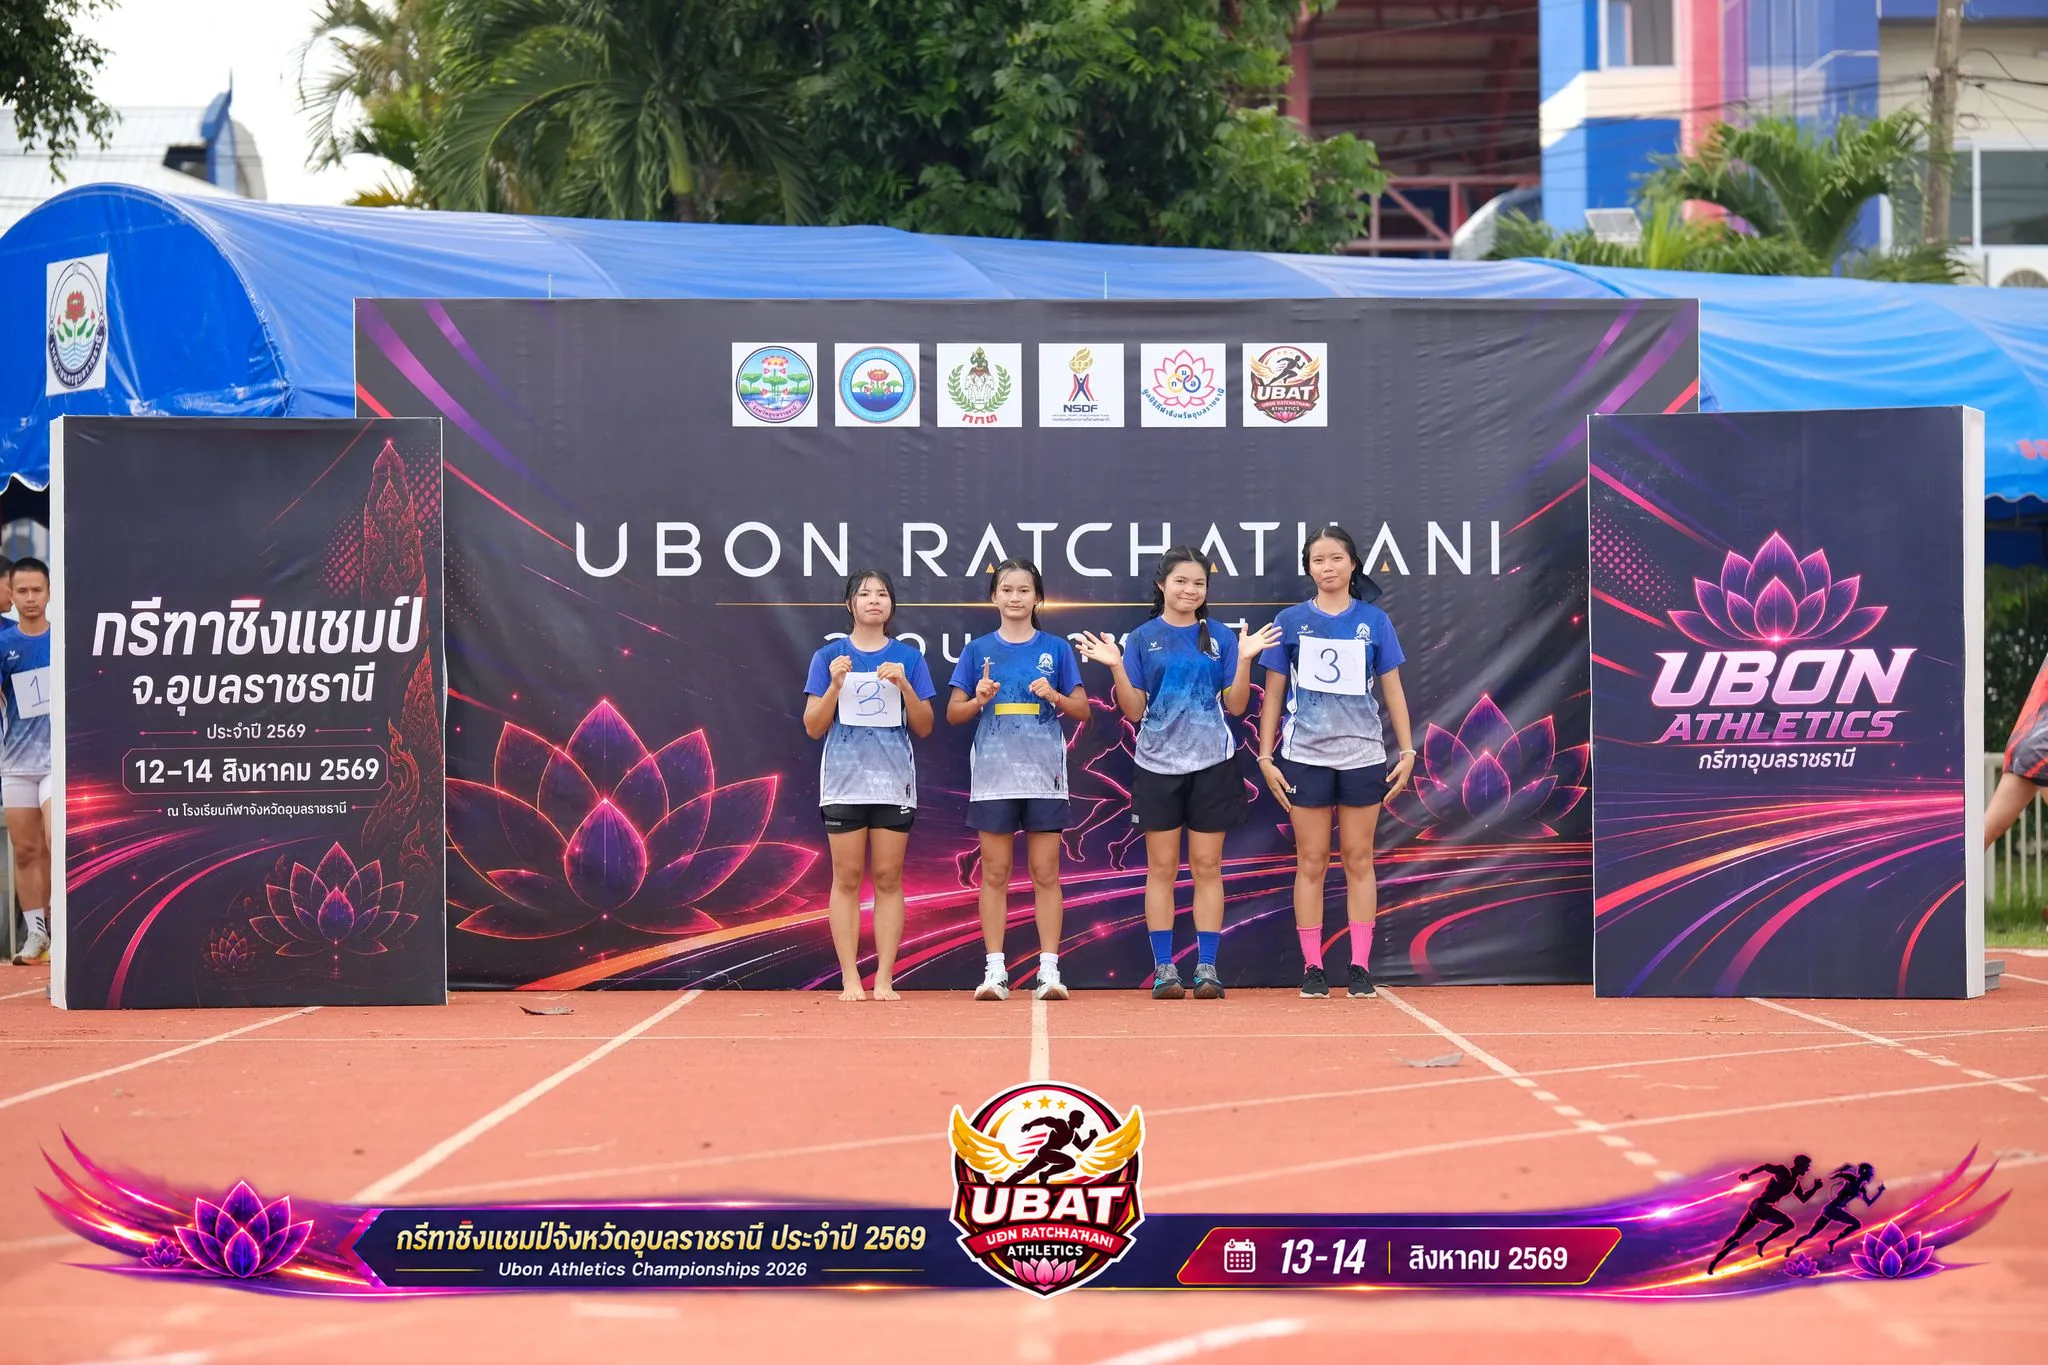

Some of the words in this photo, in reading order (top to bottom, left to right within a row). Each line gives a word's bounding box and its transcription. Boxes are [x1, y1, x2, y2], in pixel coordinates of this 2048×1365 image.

[1063, 404, 1098, 413] NSDF
[1256, 386, 1315, 400] UBAT
[575, 521, 849, 577] UBON
[92, 596, 423, 656] กรีฑาชิงแชมป์
[1314, 648, 1341, 684] 3
[1651, 648, 1918, 707] UBON
[30, 675, 50, 707] 1
[132, 661, 376, 717] จ.อุบลราชธานี
[856, 681, 886, 716] 3
[207, 722, 261, 739] ประจำปี
[266, 723, 307, 739] 2569
[1652, 711, 1908, 743] ATHLETICS
[222, 758, 311, 783] สิงหาคม
[320, 757, 380, 781] 2569
[1698, 747, 1857, 774] กรีฑาอุบลราชธานี
[167, 806, 179, 817] ณ
[183, 801, 347, 819] โรงเรียนกีฬาจังหวัดอุบลราชธานี
